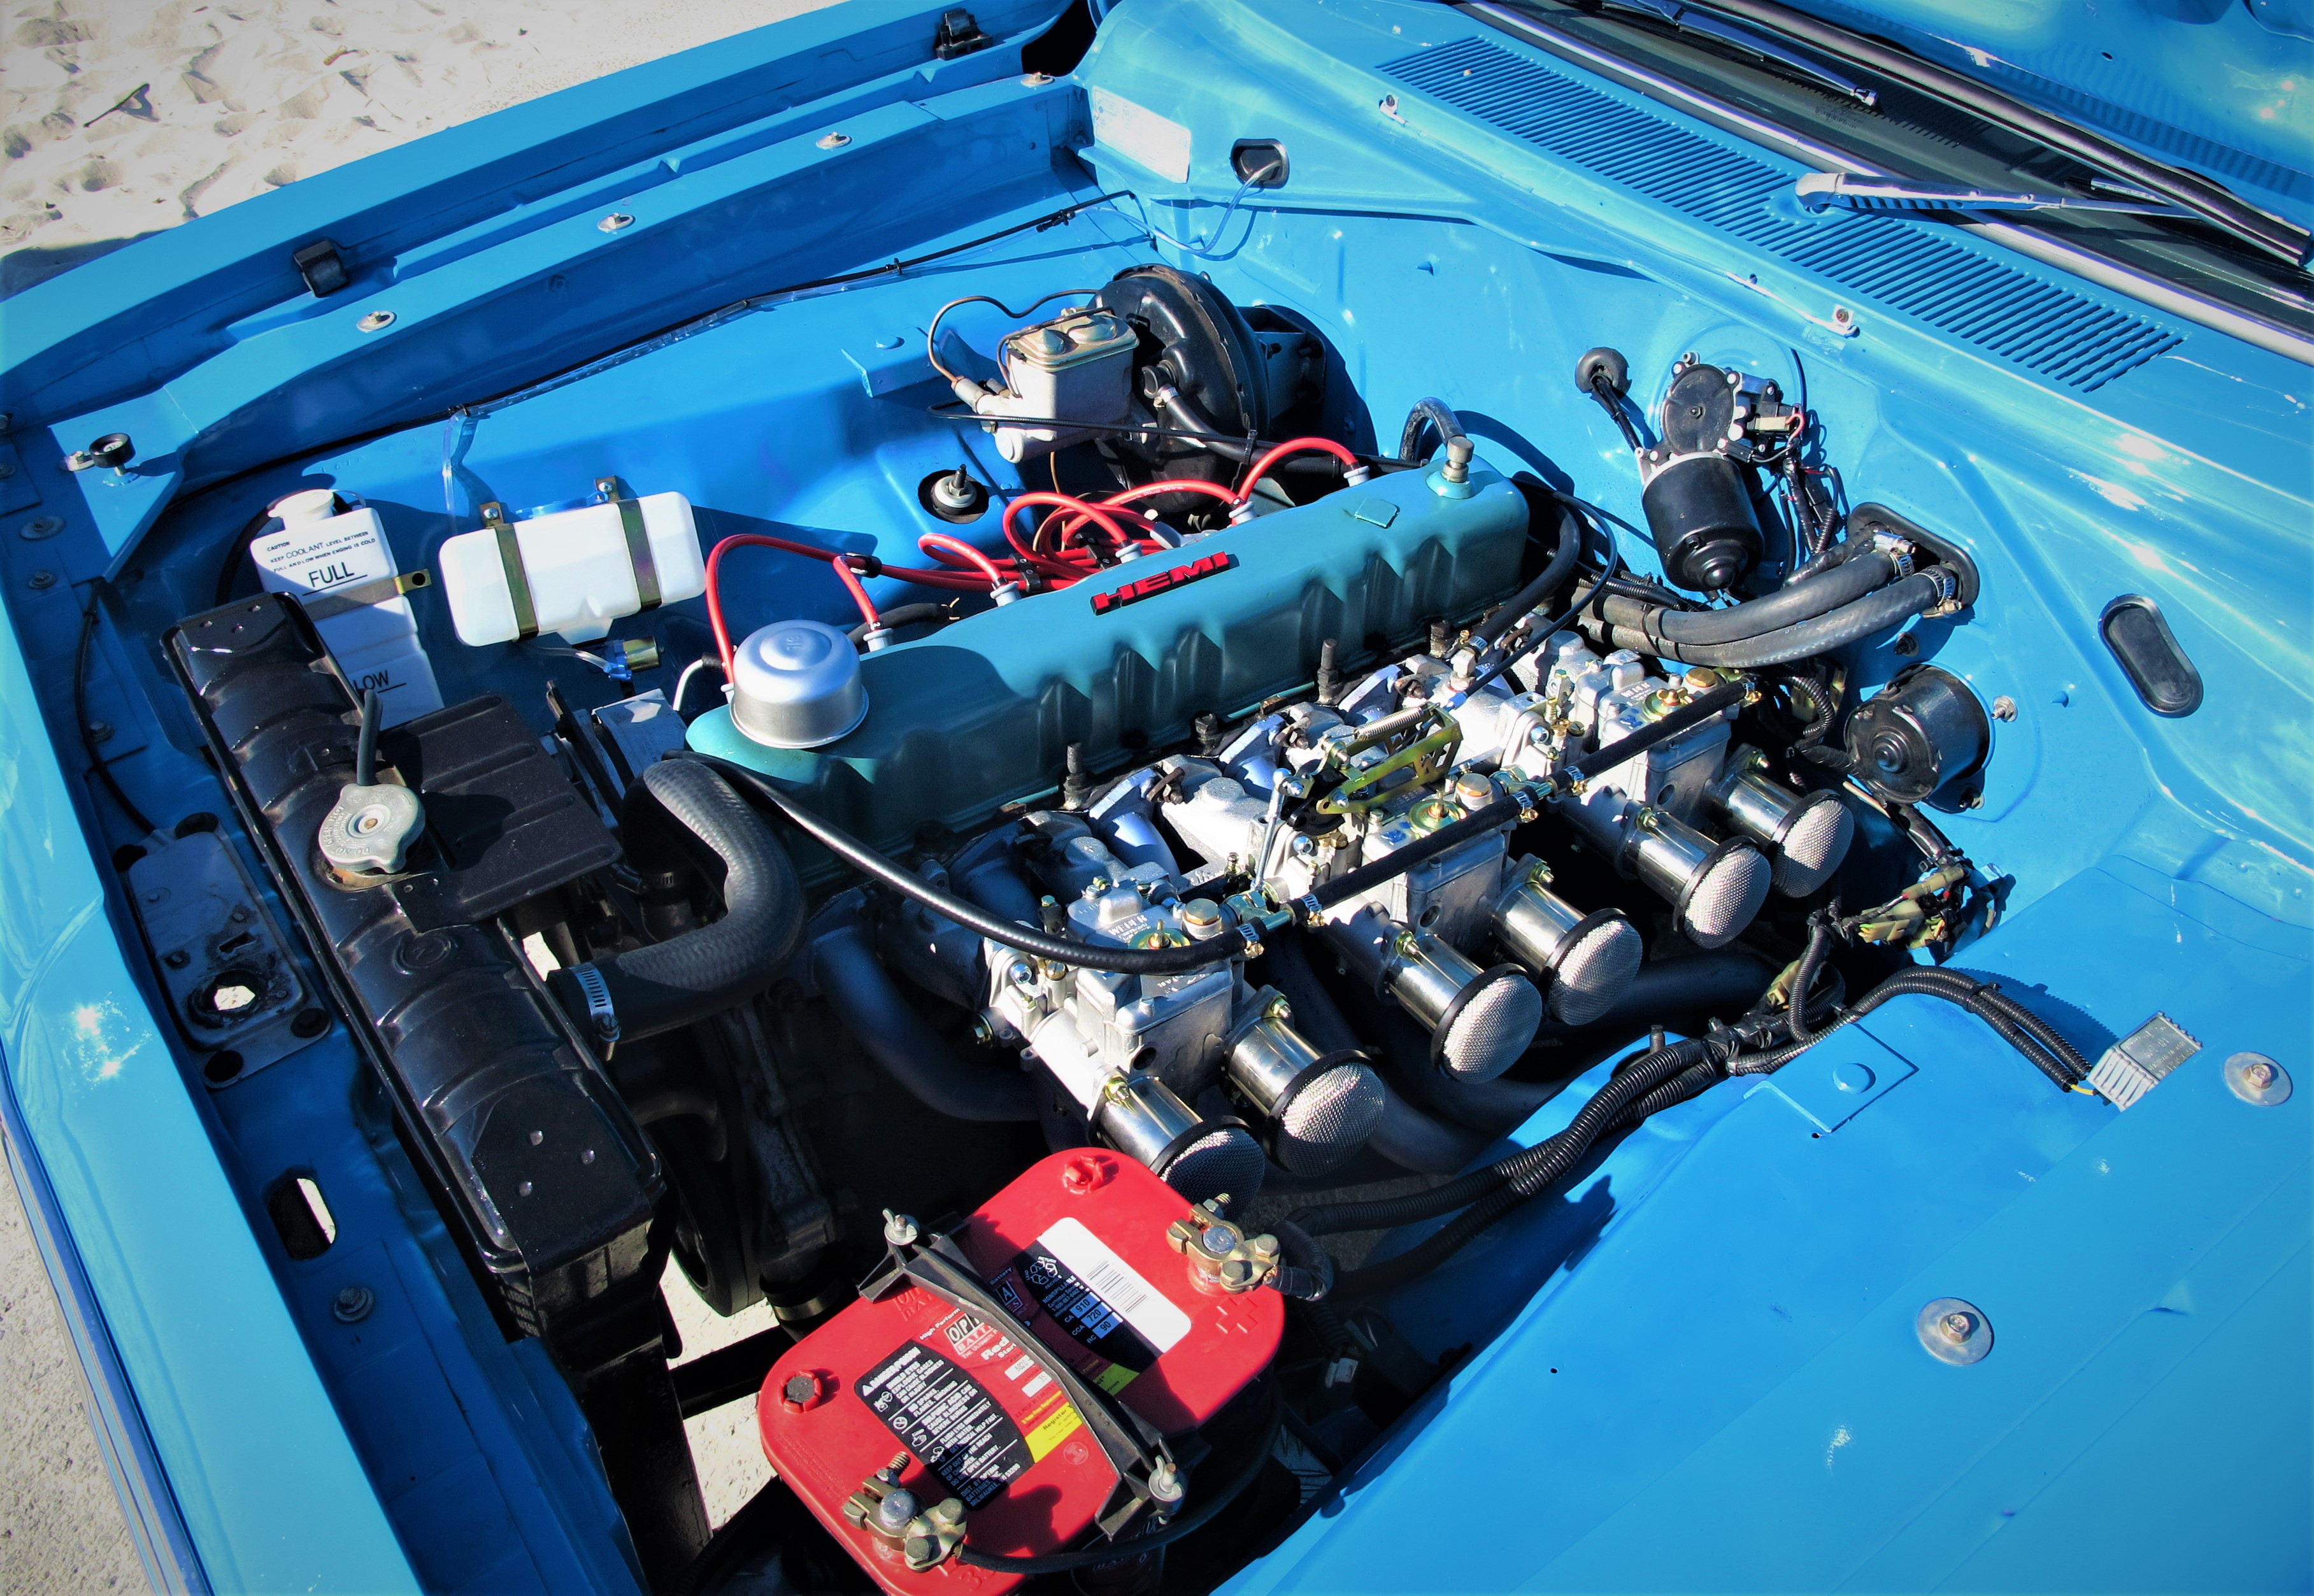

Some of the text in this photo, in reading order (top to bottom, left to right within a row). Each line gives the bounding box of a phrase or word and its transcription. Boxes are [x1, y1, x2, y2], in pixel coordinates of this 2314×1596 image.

[266, 541, 290, 552] CAUTION
[285, 541, 324, 559] COOLANT
[343, 531, 368, 541] BETWEEN
[360, 538, 375, 546] COLD
[308, 562, 355, 587] FULL
[1090, 552, 1229, 616] HEMI
[353, 670, 389, 691] LOW
[918, 1326, 936, 1341] High
[988, 1265, 1013, 1286] Battery
[1063, 1313, 1075, 1323] CA
[1075, 1297, 1090, 1313] 910
[1070, 1308, 1101, 1336] CCA 720
[1085, 1320, 1111, 1344] RC 90
[961, 1349, 973, 1359] THE
[890, 1358, 934, 1394] EXPLOSIVE GASES
[895, 1358, 945, 1399] CAN CAUSE BLINDNESS
[903, 1360, 920, 1376] EYES
[900, 1381, 927, 1404] OR INJURY
[932, 1379, 958, 1401] SMOKING
[946, 1391, 962, 1406] ACID
[959, 1383, 973, 1395] CAN
[908, 1402, 918, 1413] NO
[926, 1387, 978, 1430] CAUSE BLINDNESS OR
[1041, 1408, 1068, 1430] Register
[931, 1404, 968, 1436] SEVERE BURNS
[939, 1400, 992, 1444] FLUSH EYES IMMEDIATELY
[944, 1436, 959, 1449] WITH
[949, 1444, 960, 1454] GET
[974, 1421, 987, 1433] HELP
[940, 1464, 953, 1477] KEEP
[952, 1457, 963, 1467] OUT
[967, 1444, 978, 1454] THE
[975, 1432, 993, 1448] REACH
[945, 1473, 953, 1481] OF
[950, 1477, 960, 1486] DO
[966, 1459, 981, 1473] OPEN
[973, 1478, 981, 1486] BY
[978, 1462, 1000, 1481] OPTIMA
